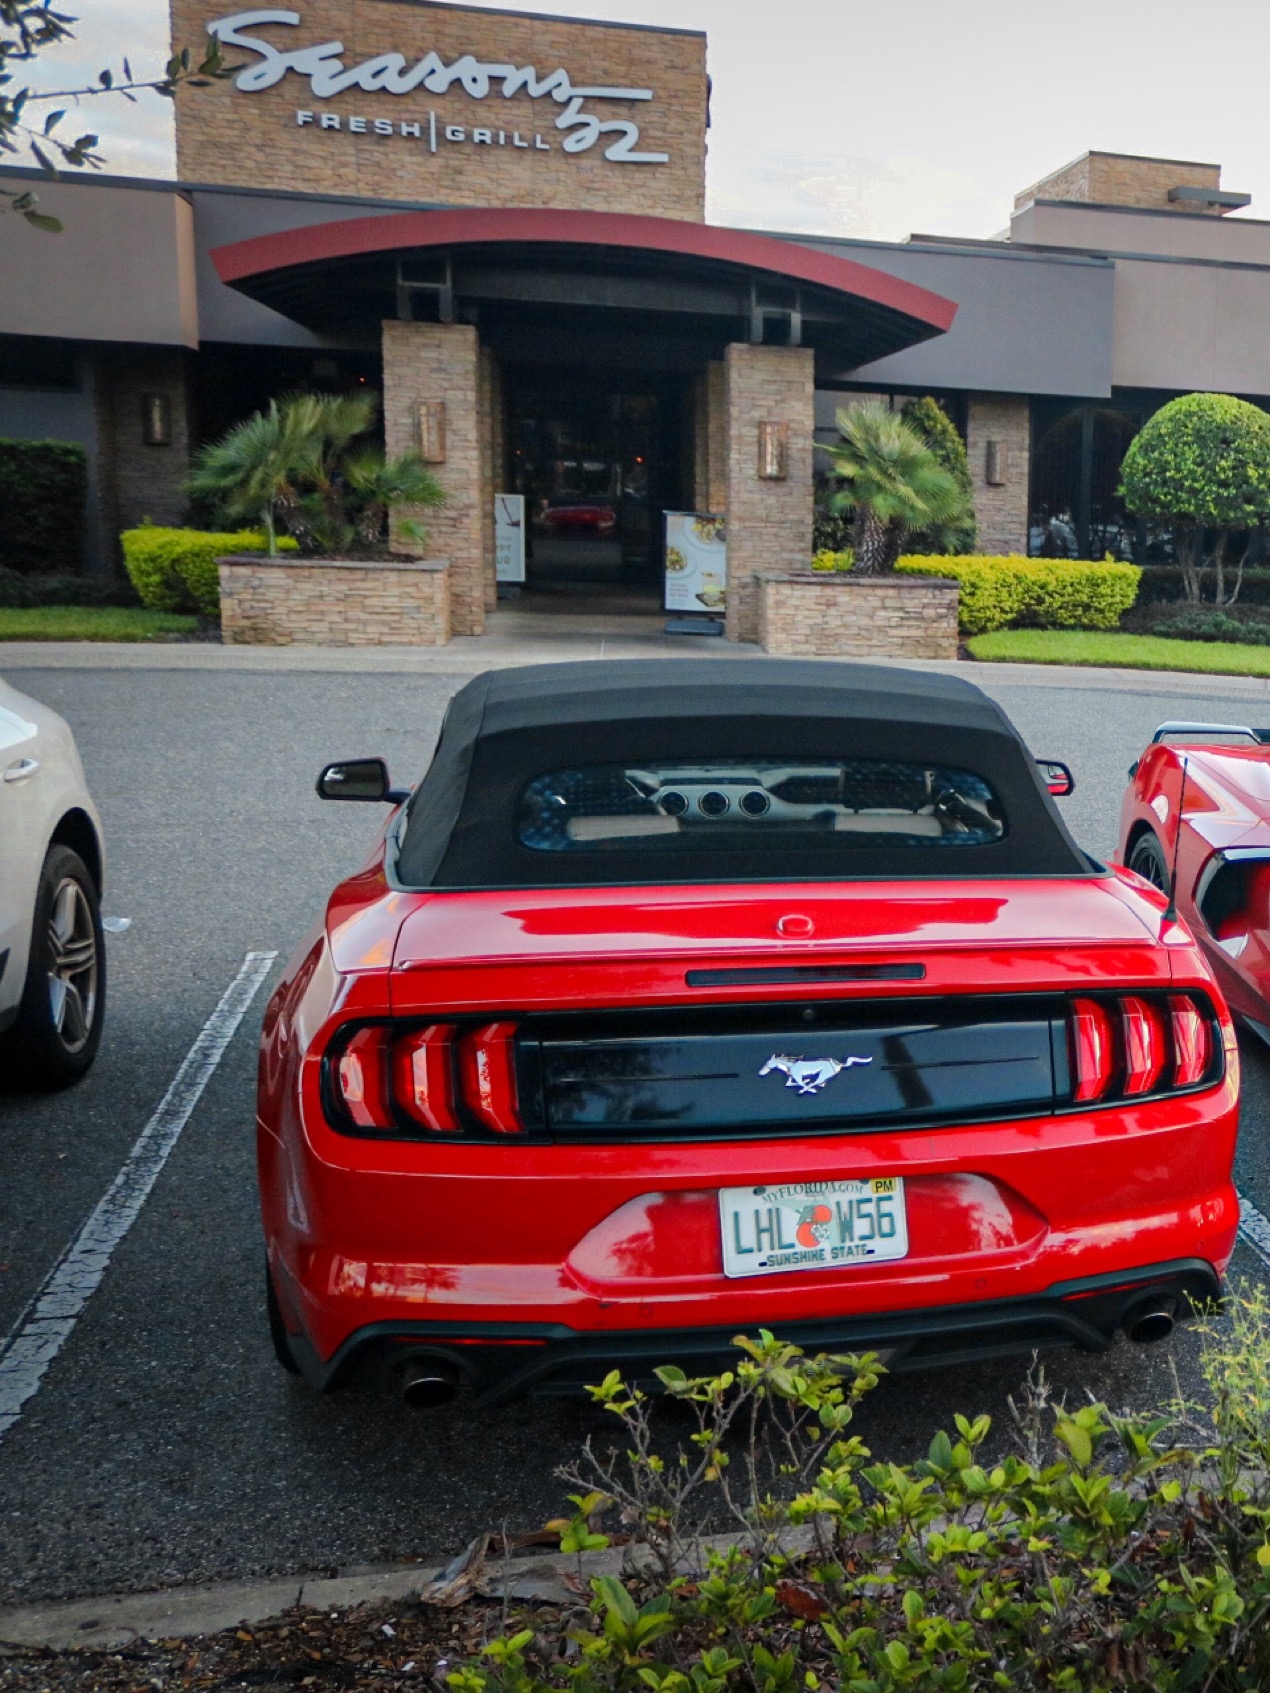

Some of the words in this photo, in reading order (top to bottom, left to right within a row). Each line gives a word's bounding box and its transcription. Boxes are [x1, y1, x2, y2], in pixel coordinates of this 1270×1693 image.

[207, 10, 653, 102] Seasons
[297, 109, 422, 138] FRESH
[445, 126, 550, 151] GRILL
[555, 97, 669, 163] 52
[875, 1179, 893, 1193] PM
[733, 1207, 796, 1255] LHL
[836, 1196, 897, 1244] W56
[766, 1248, 826, 1268] SUNSHINE
[831, 1243, 867, 1260] STATE
